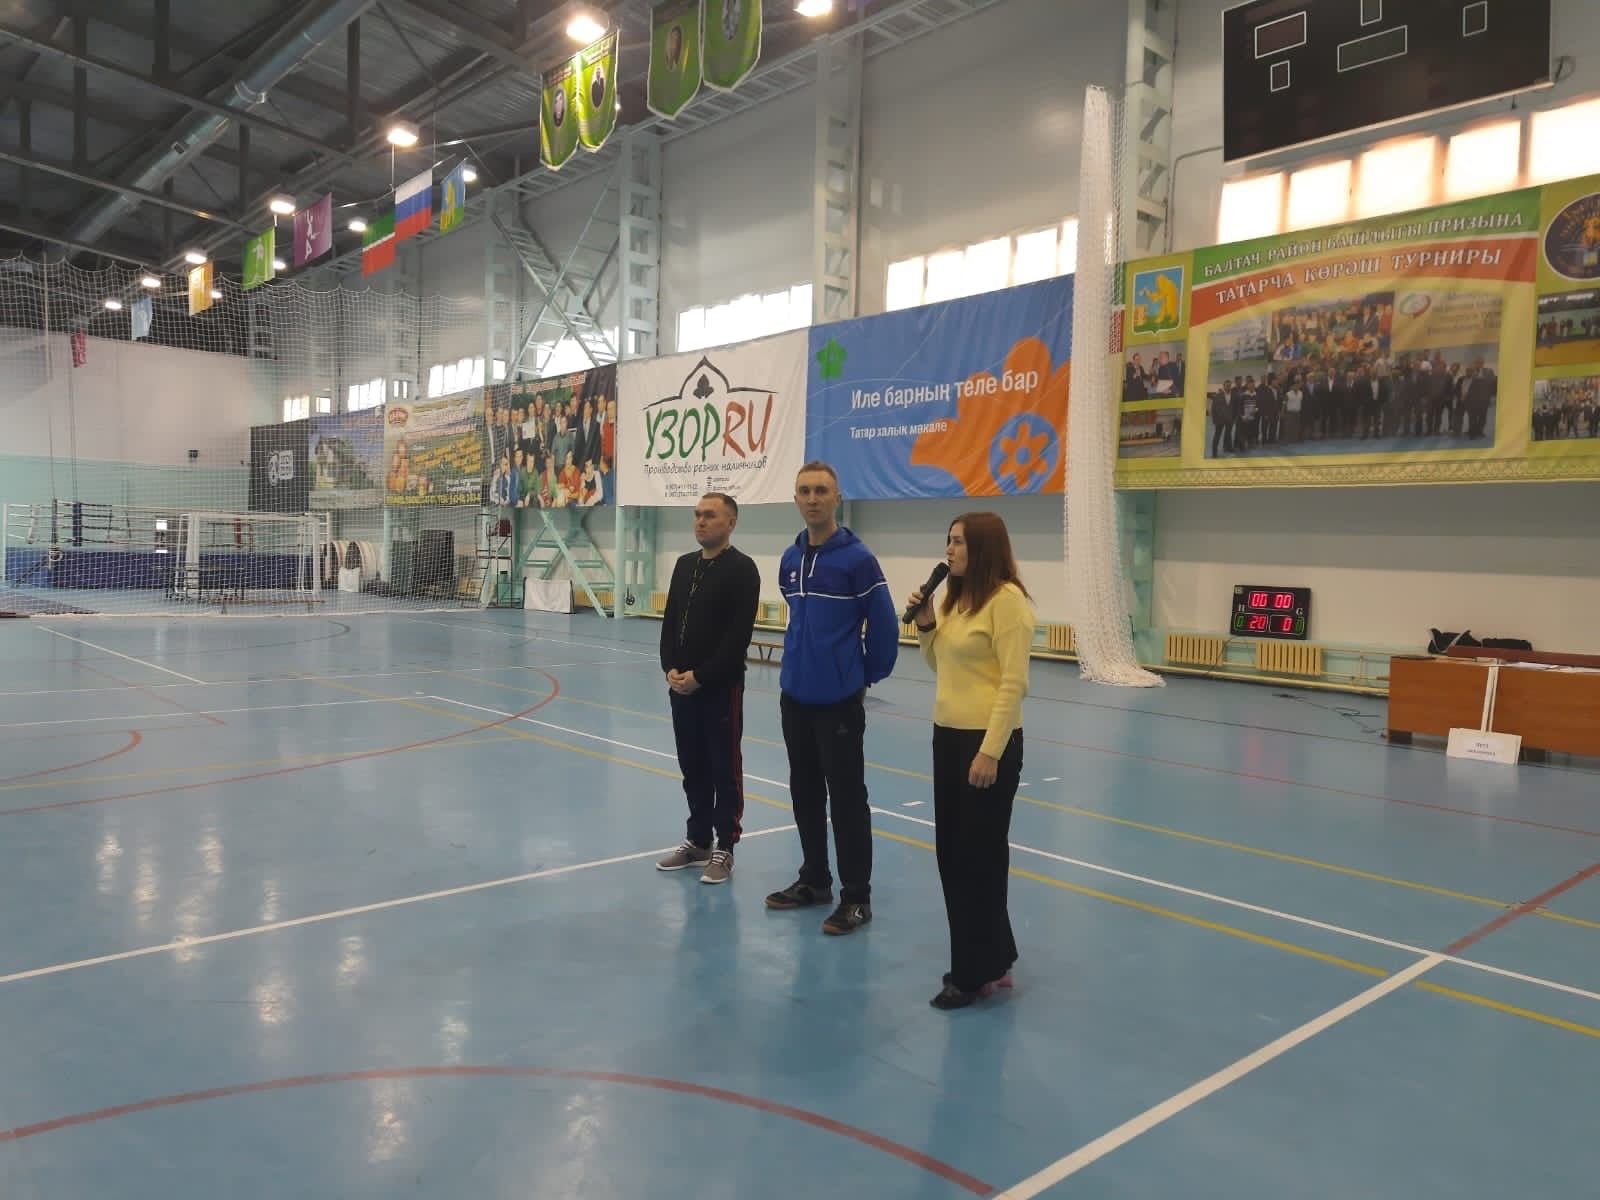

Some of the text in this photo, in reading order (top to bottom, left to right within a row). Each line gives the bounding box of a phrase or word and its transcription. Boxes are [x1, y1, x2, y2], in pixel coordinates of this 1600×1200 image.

[1204, 251, 1261, 277] БАЛТАЧ
[1268, 239, 1322, 261] РАЙОН
[1427, 212, 1523, 234] ПРИЗЫНА
[1215, 248, 1503, 305] ТАТАРЧА КӨРӘШ ТУРНИРЫ
[851, 369, 1039, 409] Иле барның теле бар
[850, 426, 876, 441] Татар
[876, 423, 908, 438] халык
[1252, 593, 1292, 608] 00 00
